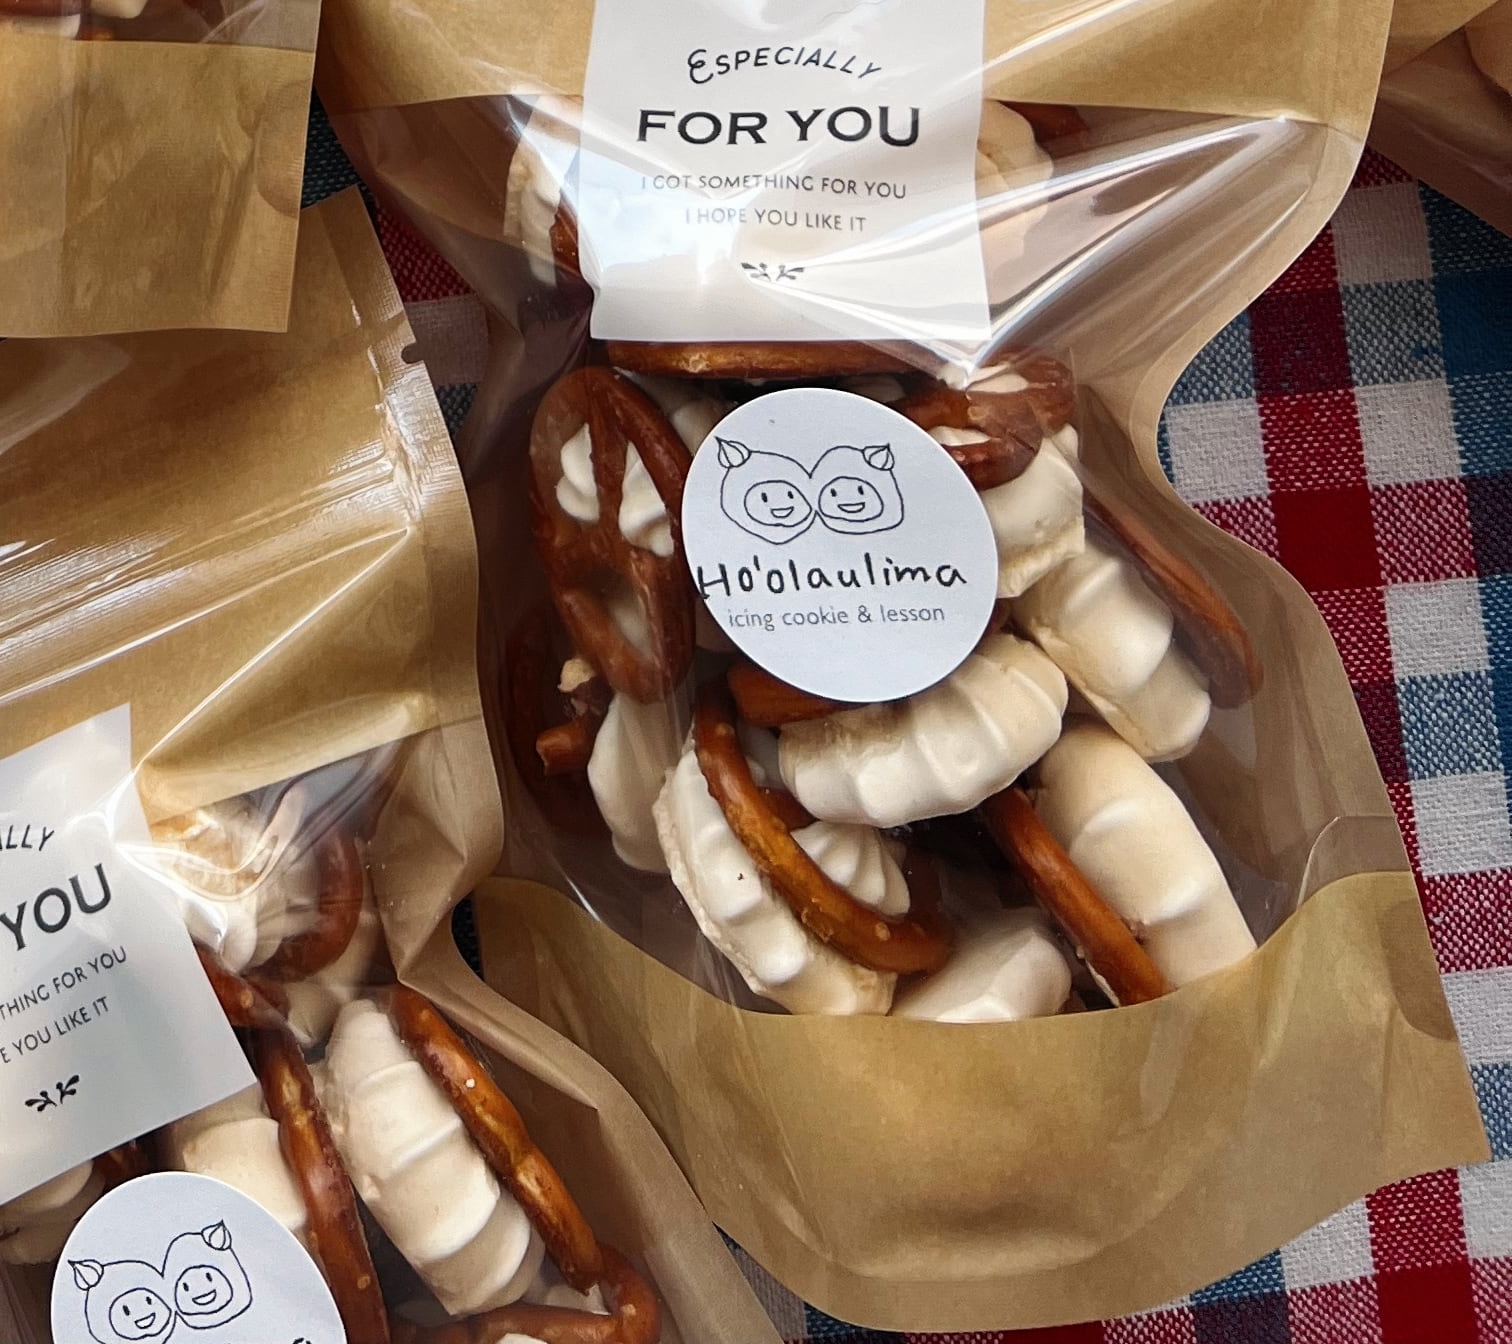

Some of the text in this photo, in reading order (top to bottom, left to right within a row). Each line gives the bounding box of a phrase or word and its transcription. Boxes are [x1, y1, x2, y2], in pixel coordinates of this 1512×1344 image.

[688, 46, 881, 84] ESPECIALLY
[638, 106, 920, 147] FOR YOU
[653, 176, 692, 189] GOT
[699, 174, 814, 191] SOMETHING
[822, 178, 857, 195] FOR
[864, 182, 906, 199] YOU
[697, 209, 746, 223] HOPE
[754, 210, 797, 226] YOU
[806, 213, 842, 230] LIKE
[850, 217, 867, 231] IT
[729, 604, 944, 631] icing cookie & lesson
[53, 967, 88, 994] FOR
[88, 946, 127, 975] YOU
[12, 1026, 52, 1056] YOU
[56, 1007, 92, 1036] LIKE
[92, 996, 110, 1022] IT
